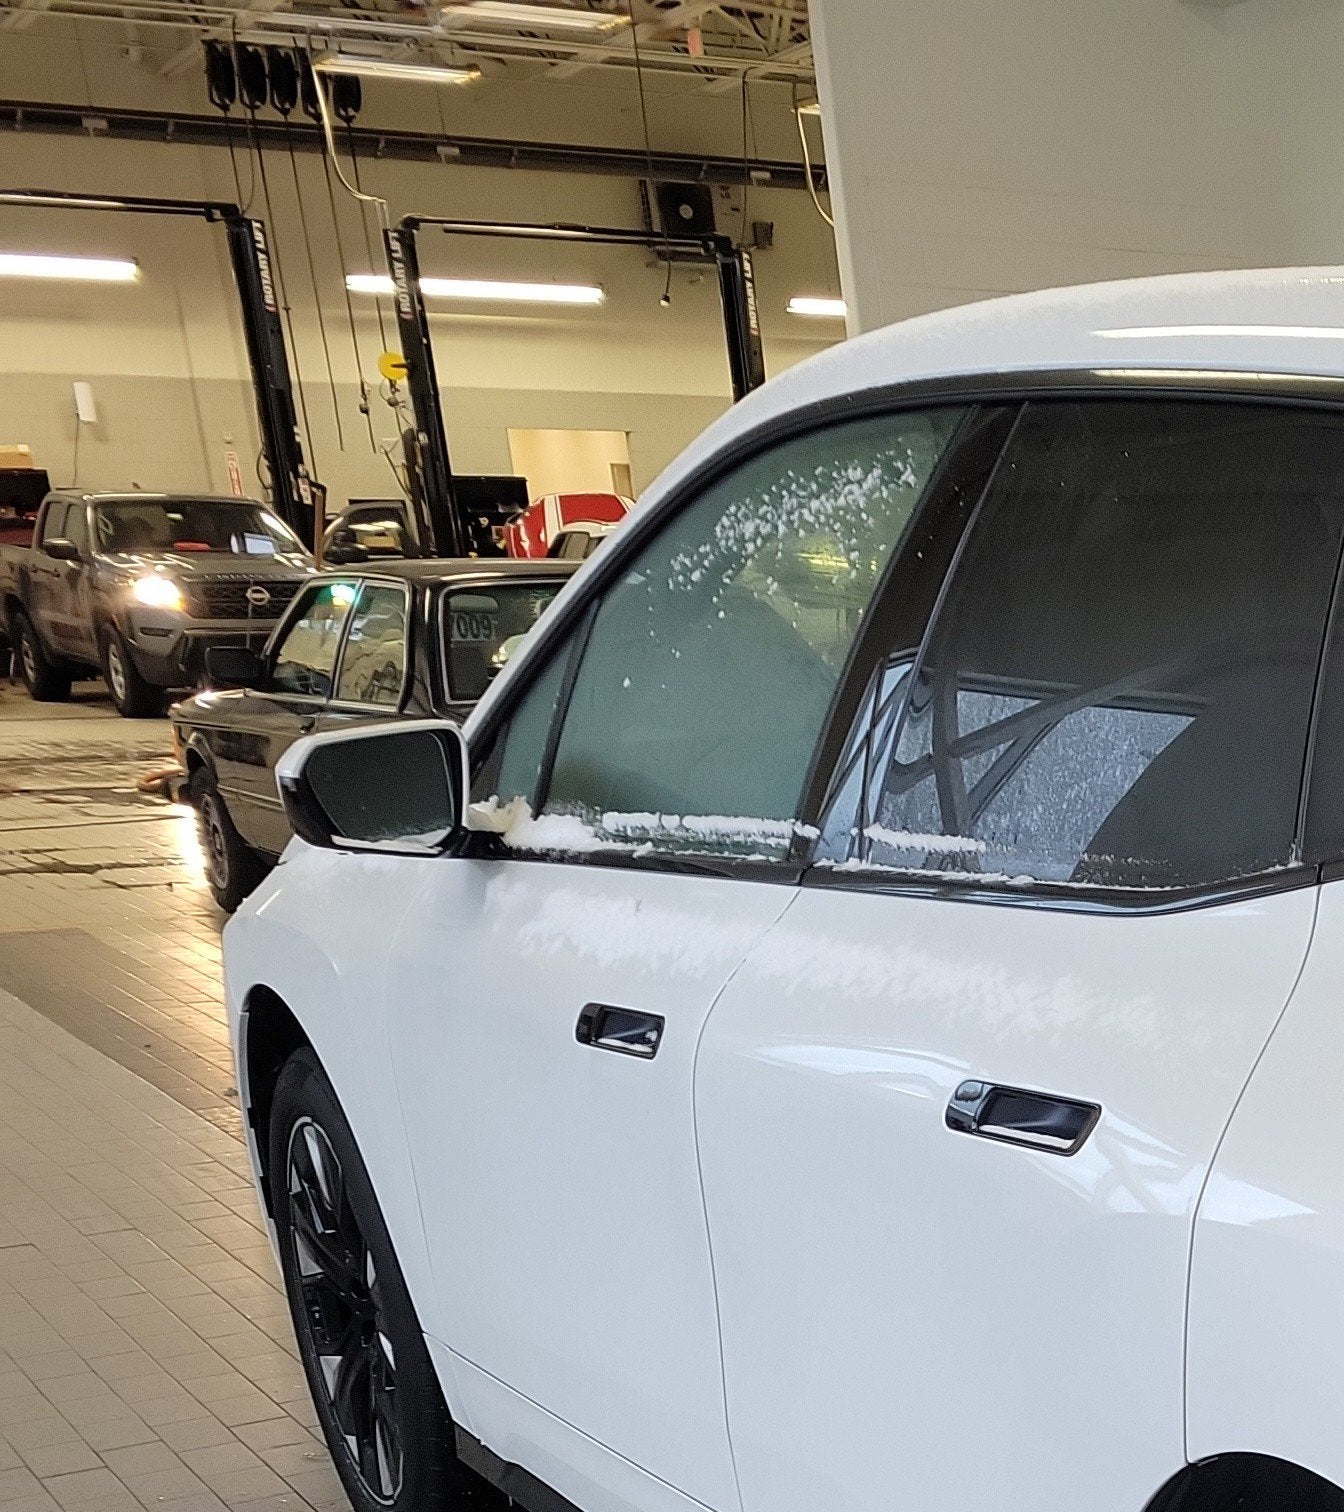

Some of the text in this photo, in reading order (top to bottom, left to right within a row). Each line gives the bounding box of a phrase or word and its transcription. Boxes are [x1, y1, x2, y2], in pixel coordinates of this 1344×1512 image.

[252, 220, 276, 304] ROTARY LIFT
[392, 259, 411, 312] ROTARY
